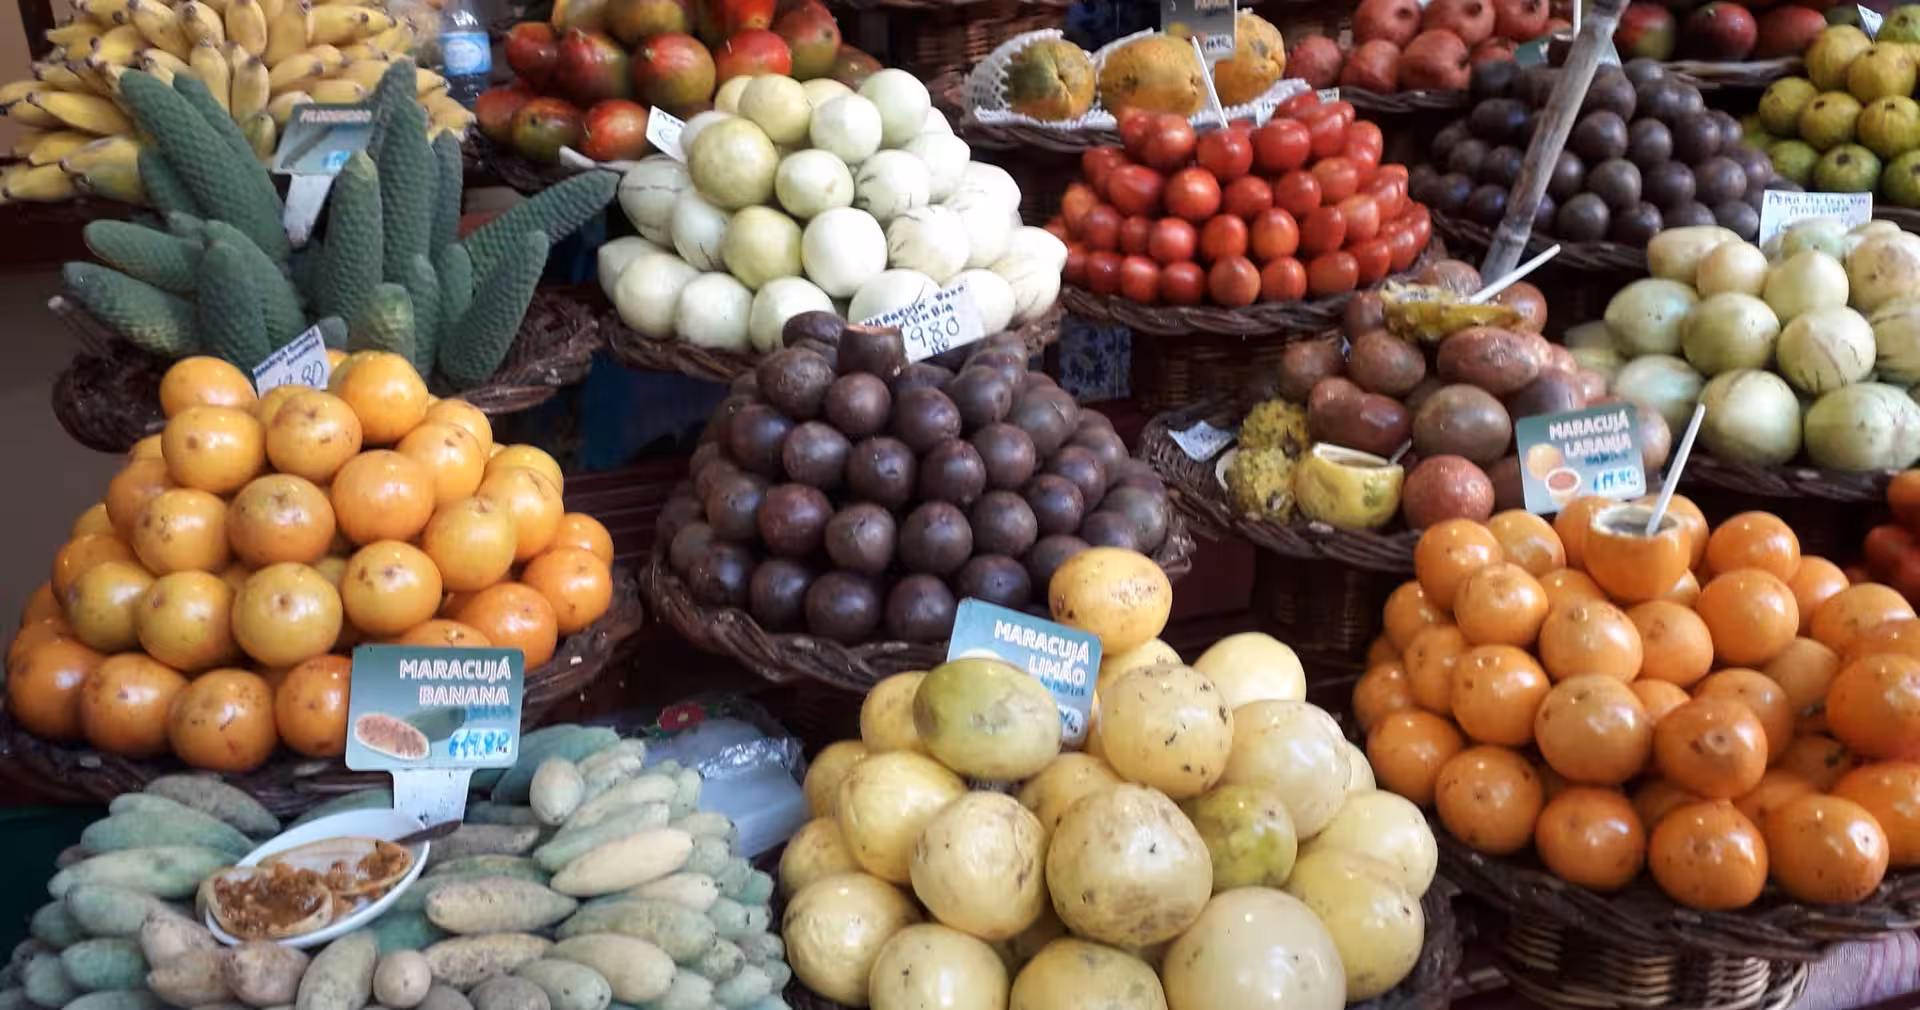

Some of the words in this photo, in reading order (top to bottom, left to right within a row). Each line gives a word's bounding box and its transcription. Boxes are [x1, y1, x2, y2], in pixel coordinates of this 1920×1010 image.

[1548, 409, 1630, 441] MARACUJÁ
[1564, 433, 1632, 458] LARANJA
[994, 619, 1089, 665] MARACUJÁ
[400, 656, 511, 683] MARACUJÁ
[1028, 654, 1087, 687] LIMÃO
[419, 686, 510, 706] BANANA
